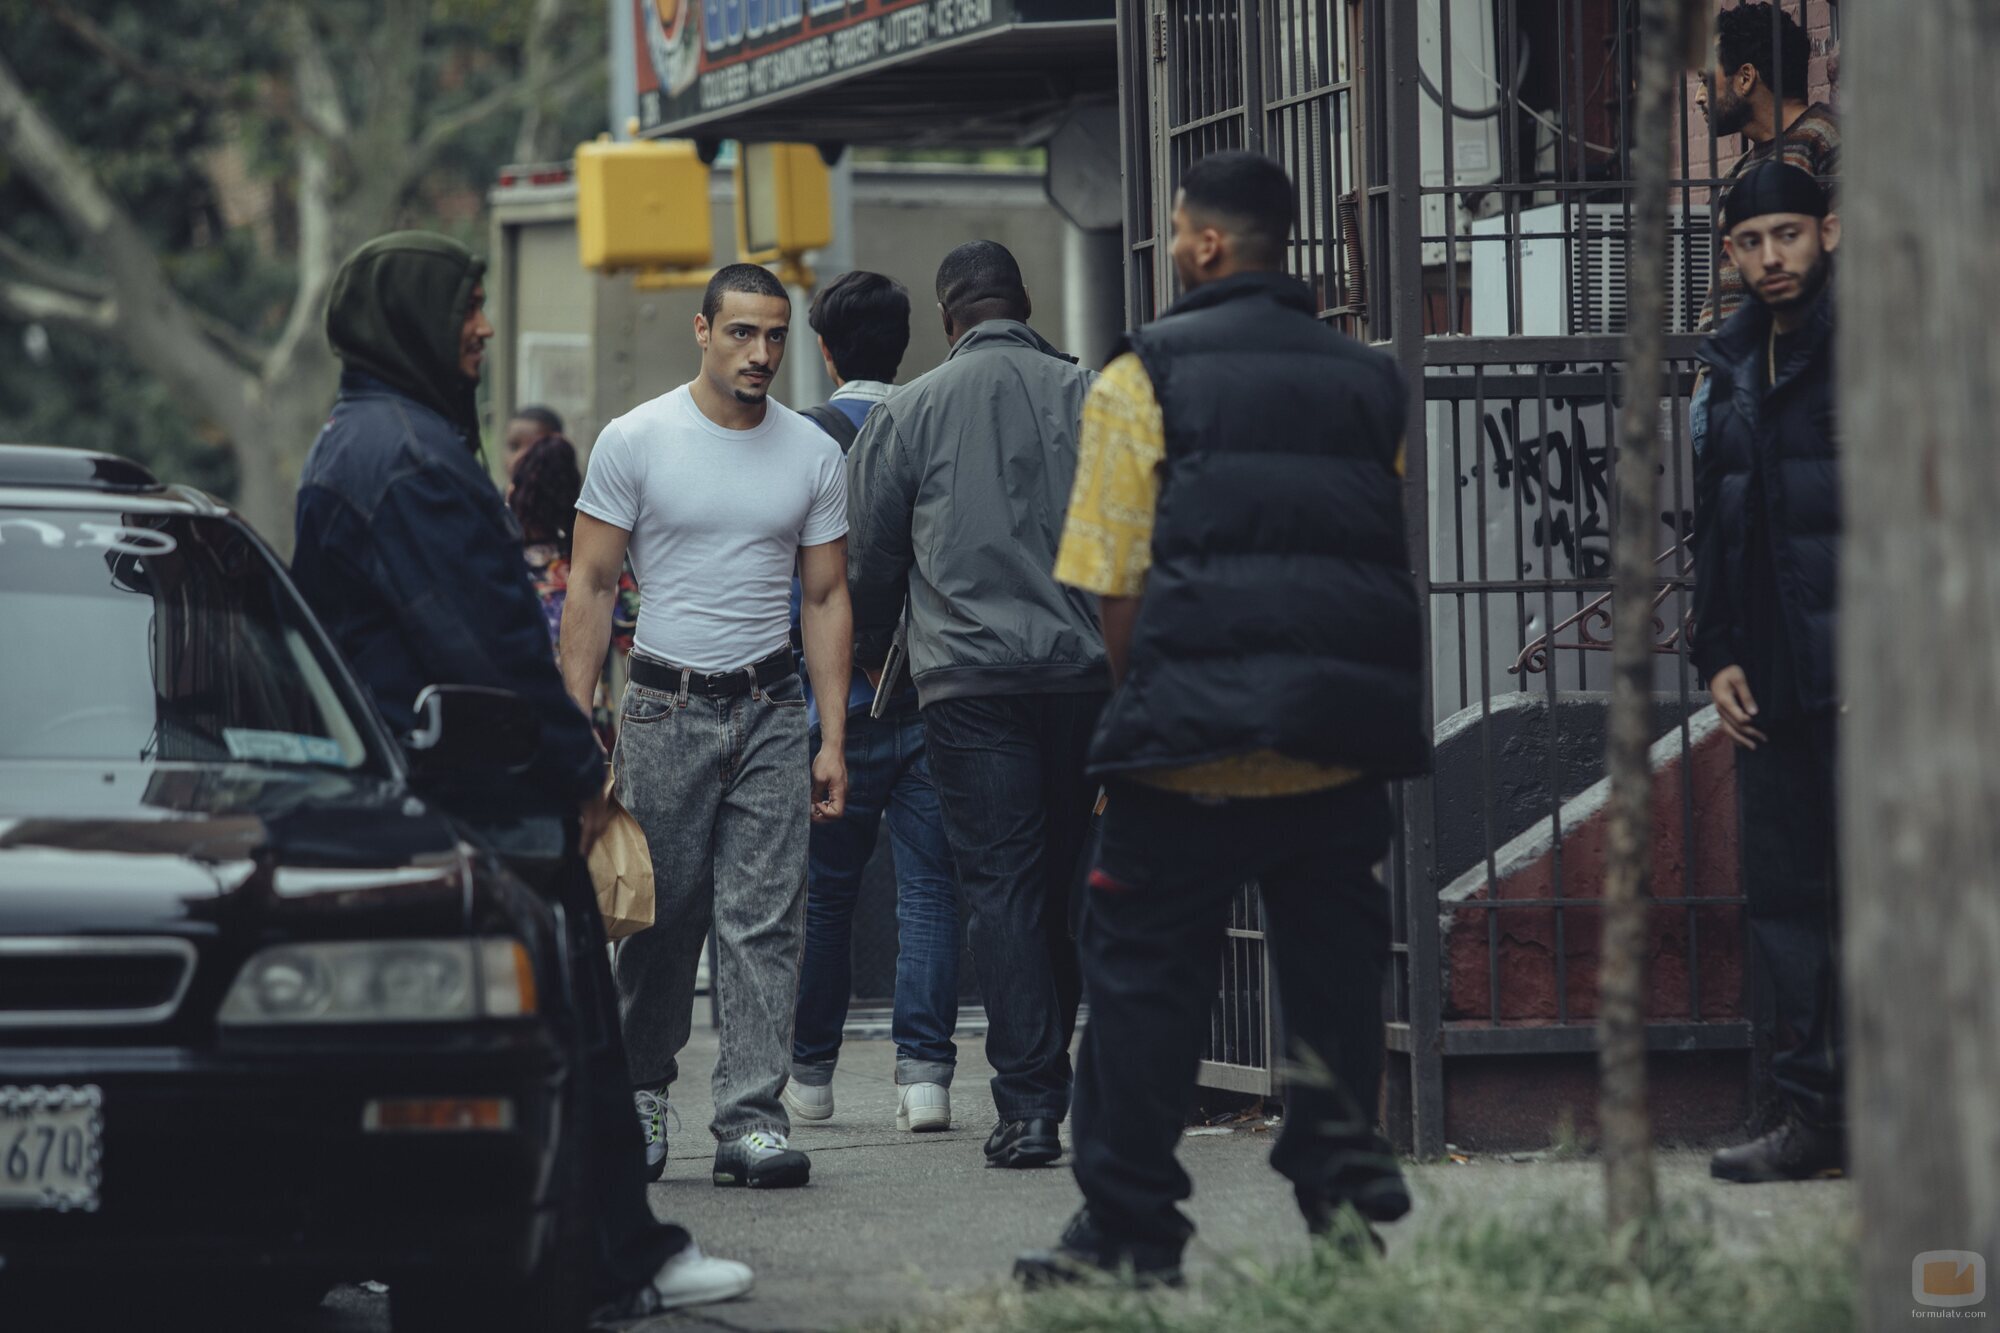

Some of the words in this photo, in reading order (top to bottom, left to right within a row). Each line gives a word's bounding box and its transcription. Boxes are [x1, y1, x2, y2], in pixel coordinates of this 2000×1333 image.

[834, 18, 879, 68] GROCERY
[884, 2, 929, 52] LOTTERY
[936, 0, 954, 35] ICE
